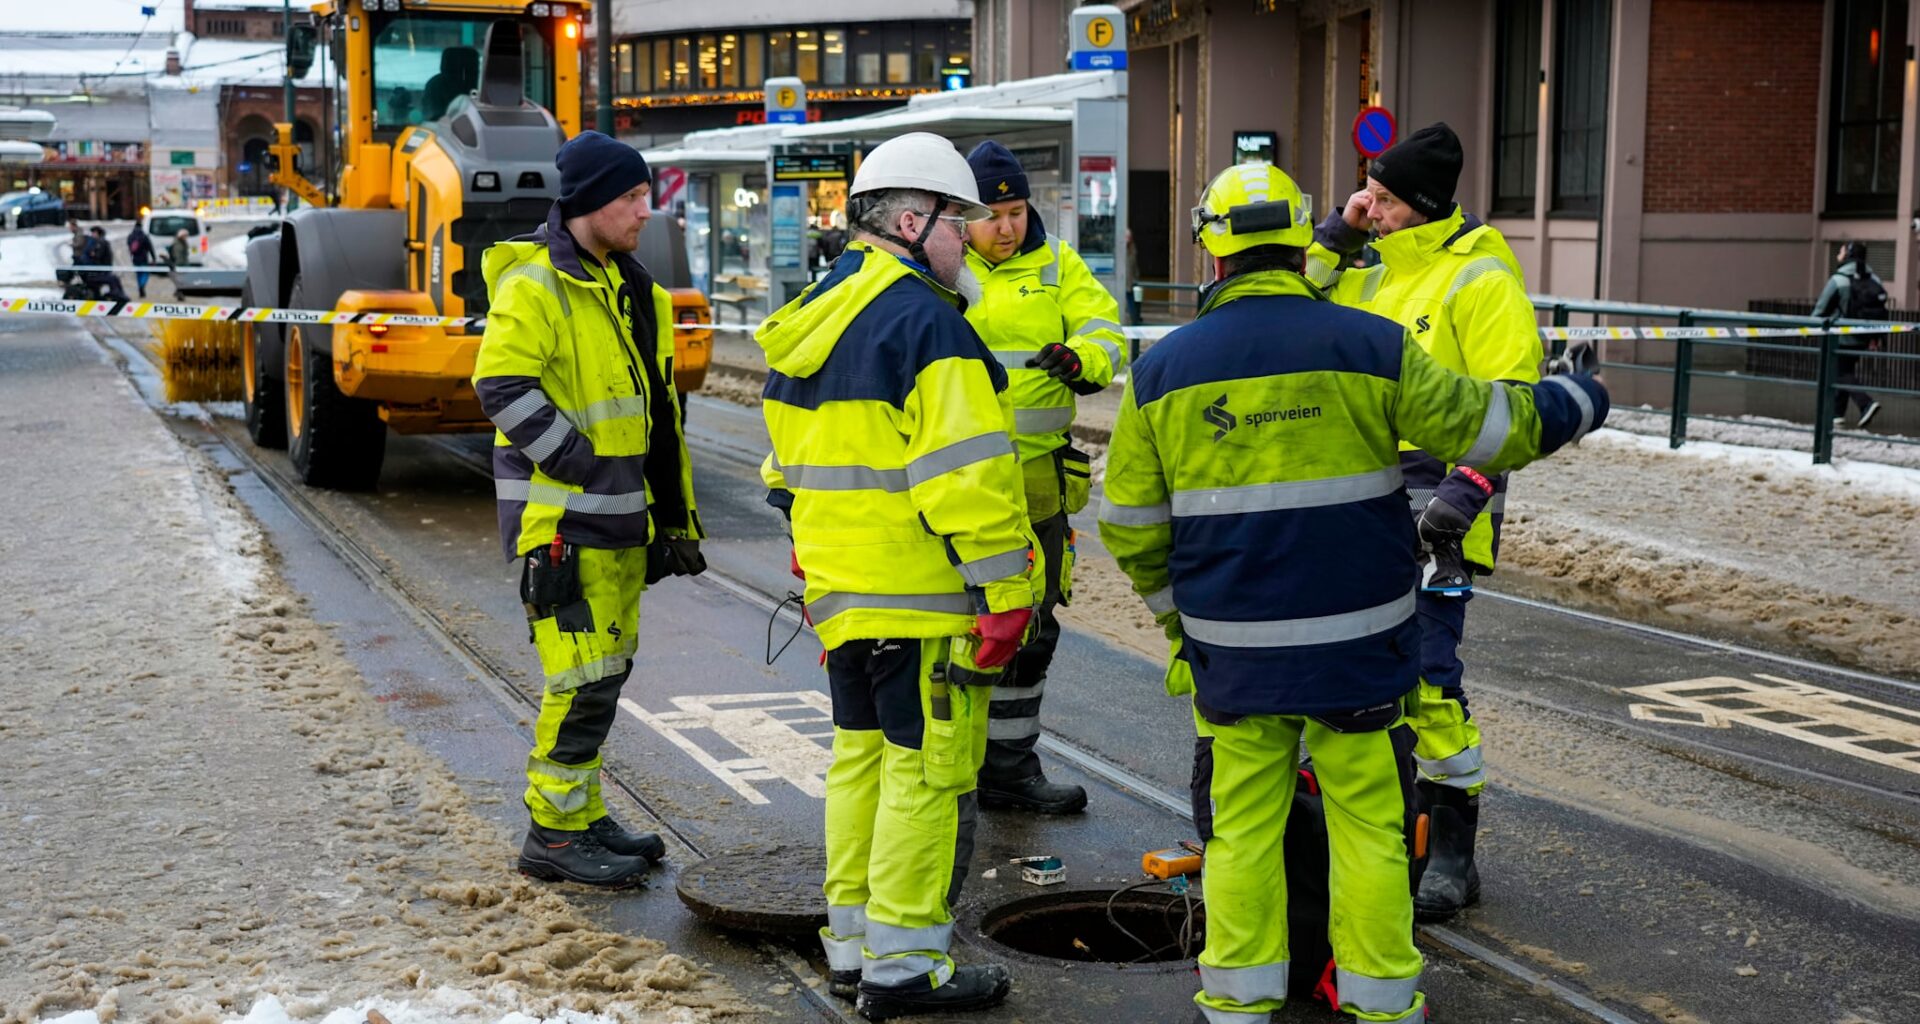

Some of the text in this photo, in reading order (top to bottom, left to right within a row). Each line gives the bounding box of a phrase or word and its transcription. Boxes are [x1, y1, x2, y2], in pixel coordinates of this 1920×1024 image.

[1094, 22, 1107, 43] F
[781, 90, 790, 106] F
[735, 109, 822, 125] POR
[28, 301, 76, 313] POLITI
[153, 304, 201, 315] POLITI
[271, 312, 319, 322] POLITI
[393, 314, 440, 323] POLITI
[1244, 404, 1322, 428] sporveien
